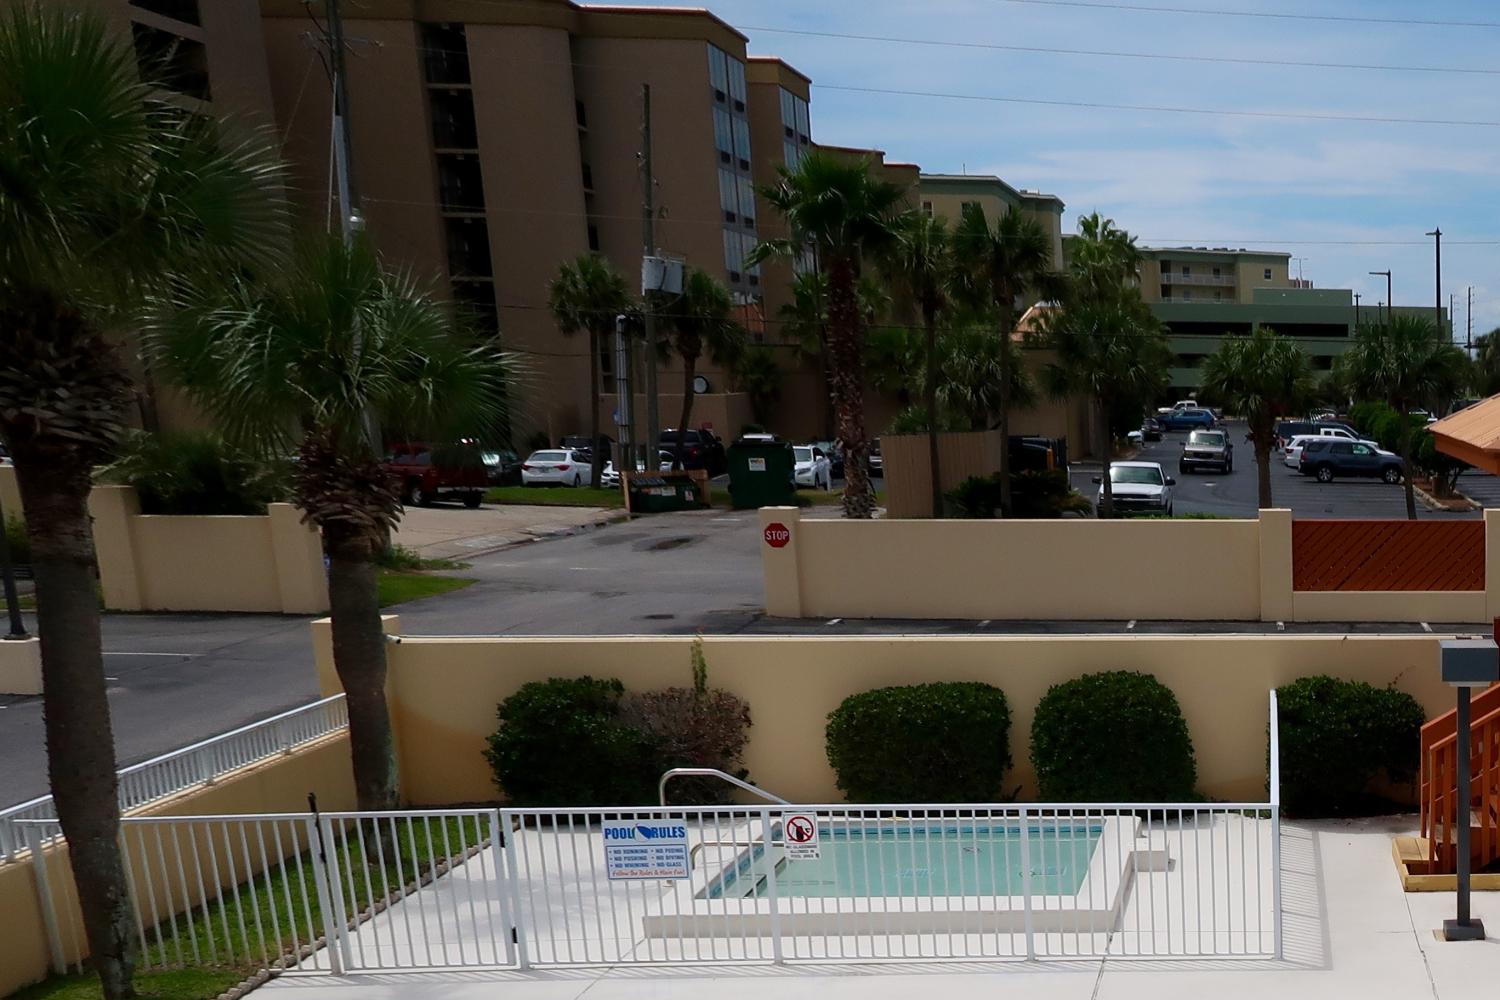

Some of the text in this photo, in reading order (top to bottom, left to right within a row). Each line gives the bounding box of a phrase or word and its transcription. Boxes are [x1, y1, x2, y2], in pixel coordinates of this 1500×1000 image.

[765, 531, 788, 541] STOP
[604, 827, 685, 839] POOL RULES
